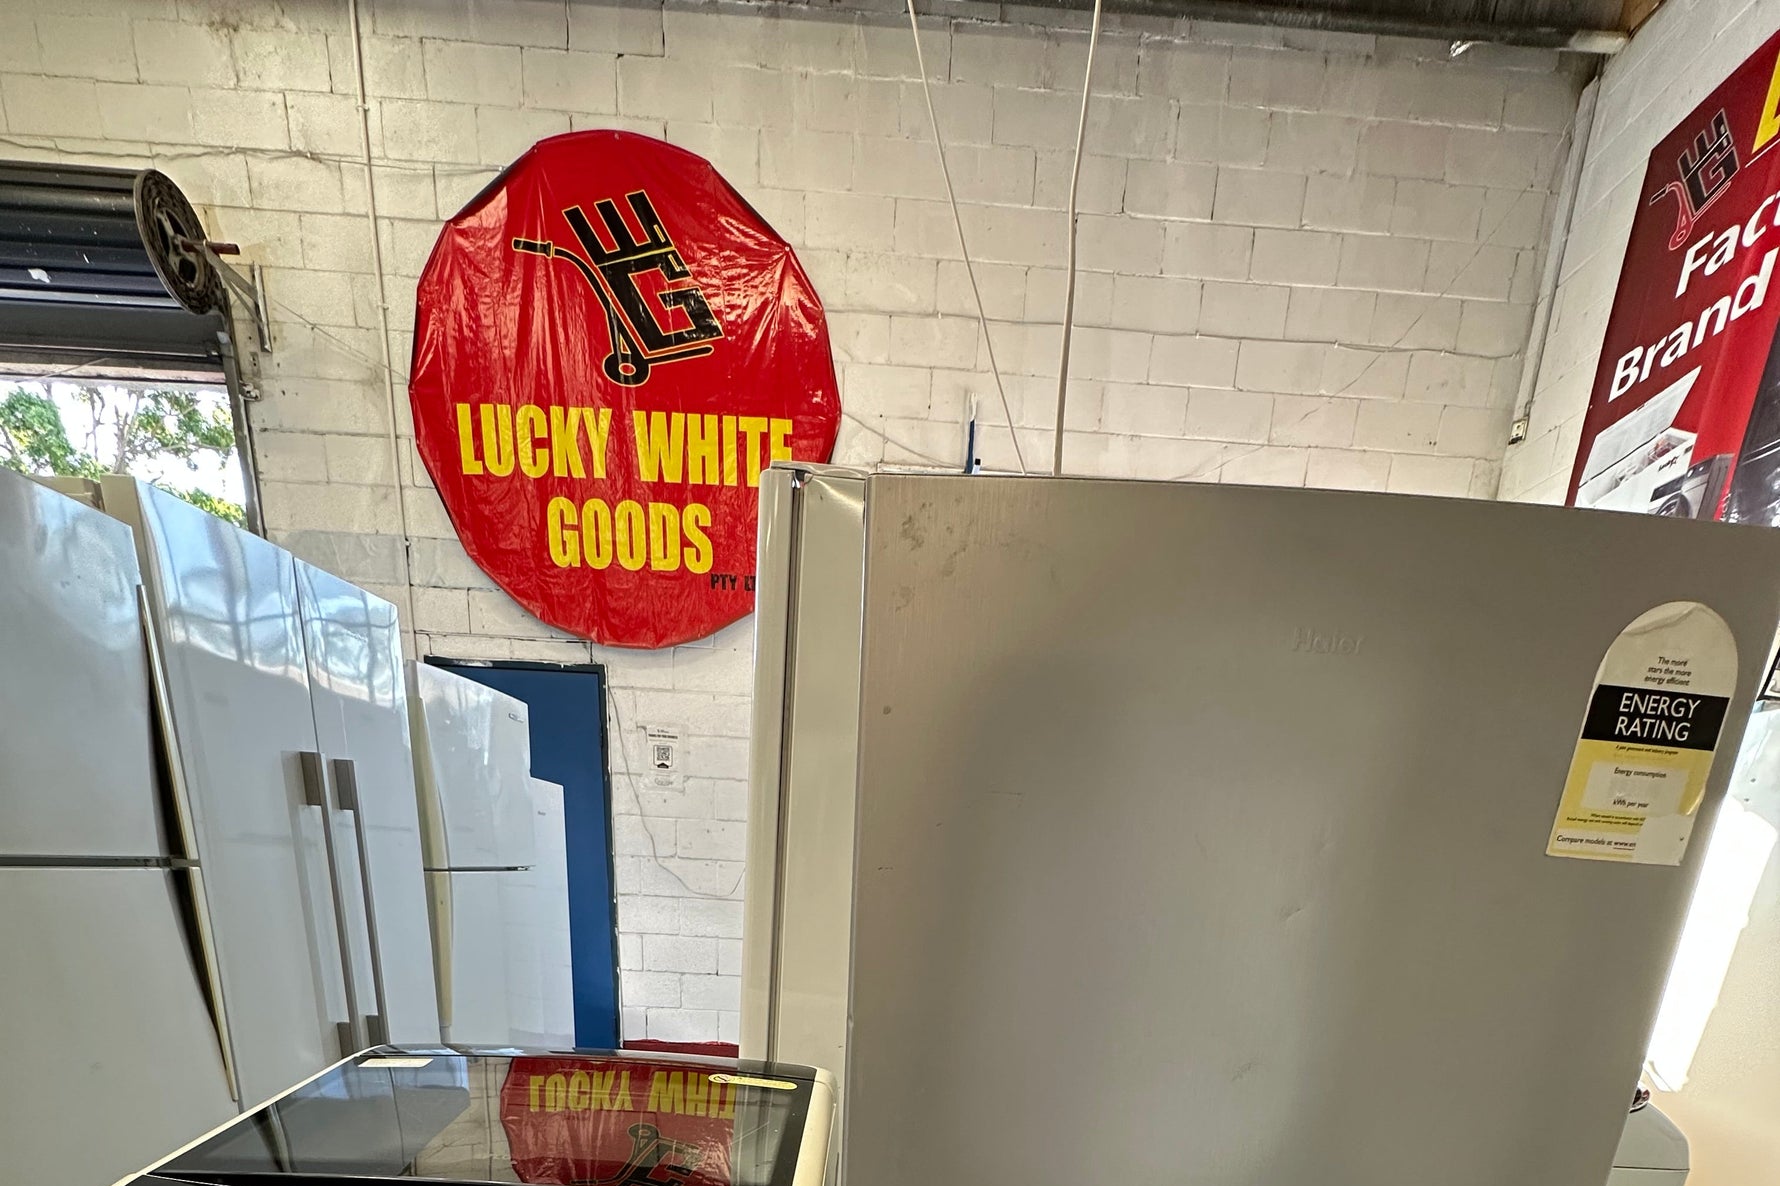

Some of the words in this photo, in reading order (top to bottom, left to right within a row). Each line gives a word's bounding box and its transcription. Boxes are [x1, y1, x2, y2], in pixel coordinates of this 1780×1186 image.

[1608, 246, 1780, 403] Brand
[456, 403, 612, 479] LUCKY
[633, 410, 793, 487] WHITE
[547, 496, 714, 574] GOODS
[710, 573, 736, 591] PTY
[744, 575, 756, 592] LT
[1658, 656, 1670, 665] The
[1664, 667, 1674, 675] the
[1644, 676, 1665, 685] energy
[1666, 677, 1690, 686] efficient
[1619, 692, 1700, 719] ENERGY
[1614, 716, 1691, 742] RATING
[1614, 767, 1632, 777] Energy
[1633, 770, 1667, 779] consumption
[1556, 835, 1585, 845] Compare
[1585, 837, 1606, 846] models
